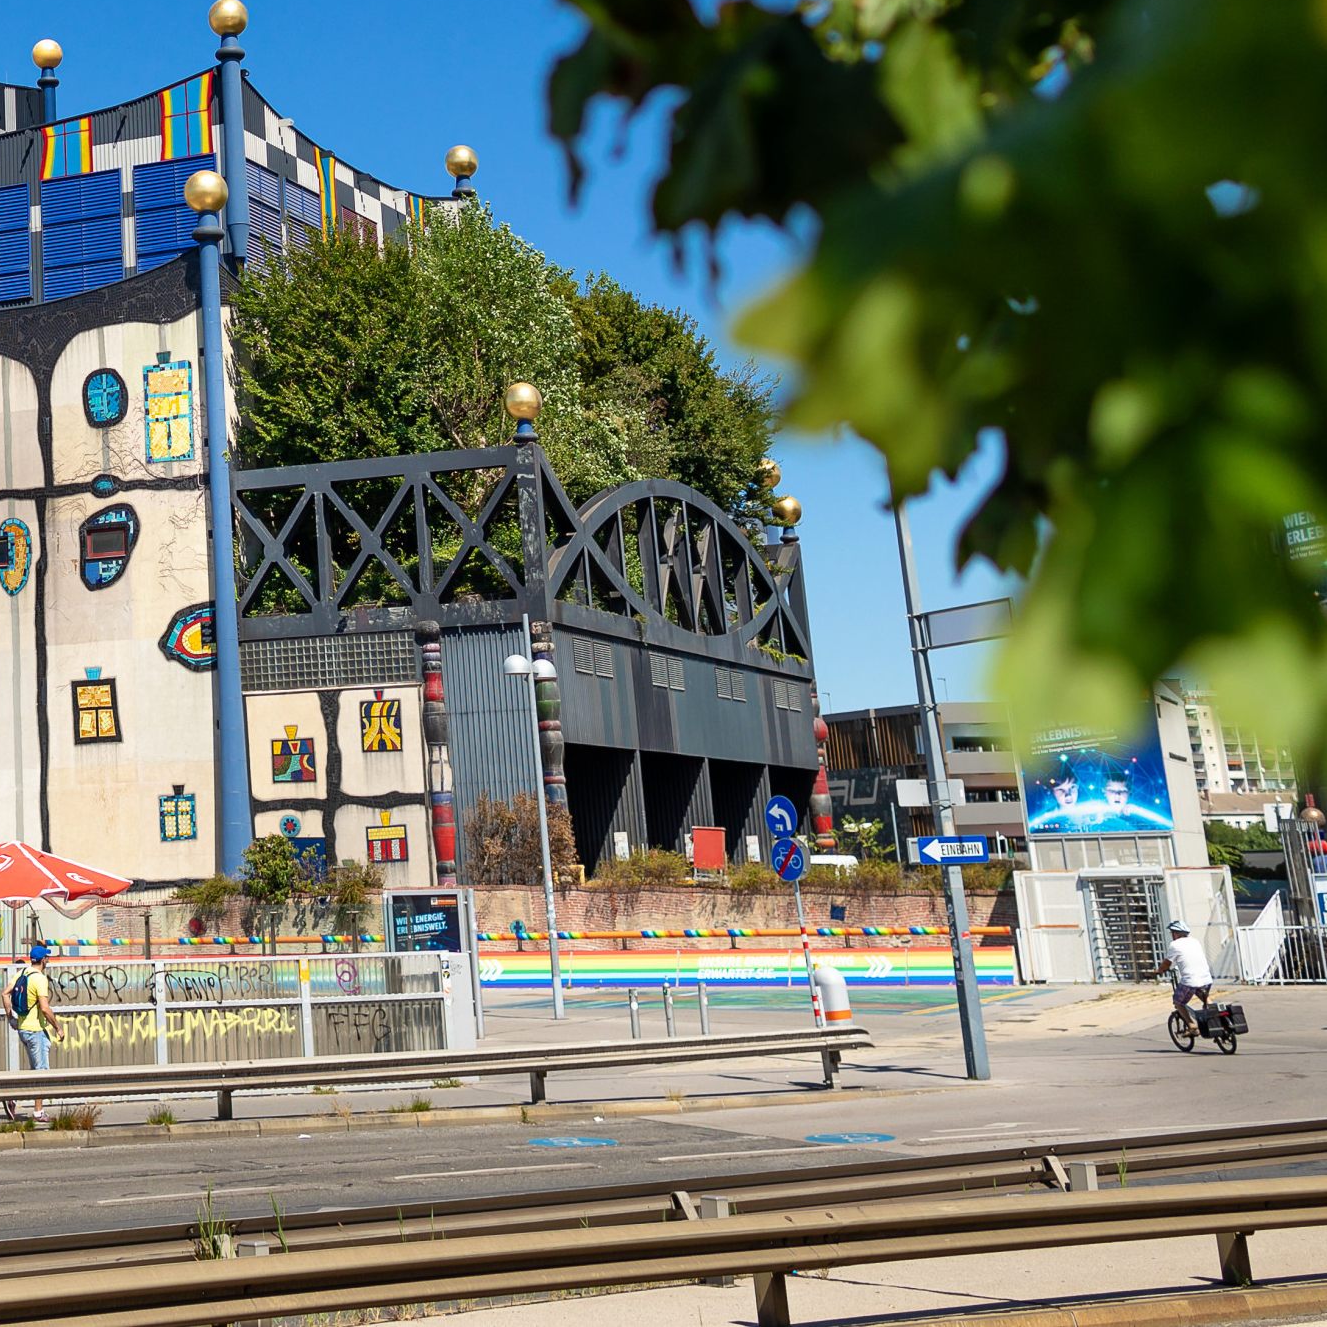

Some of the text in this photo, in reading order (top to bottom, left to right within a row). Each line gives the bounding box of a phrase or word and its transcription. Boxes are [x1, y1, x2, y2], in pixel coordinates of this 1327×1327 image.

[940, 843, 982, 857] EINBAHN
[415, 912, 446, 923] ENERGIE-
[328, 1007, 392, 1047] FFG
